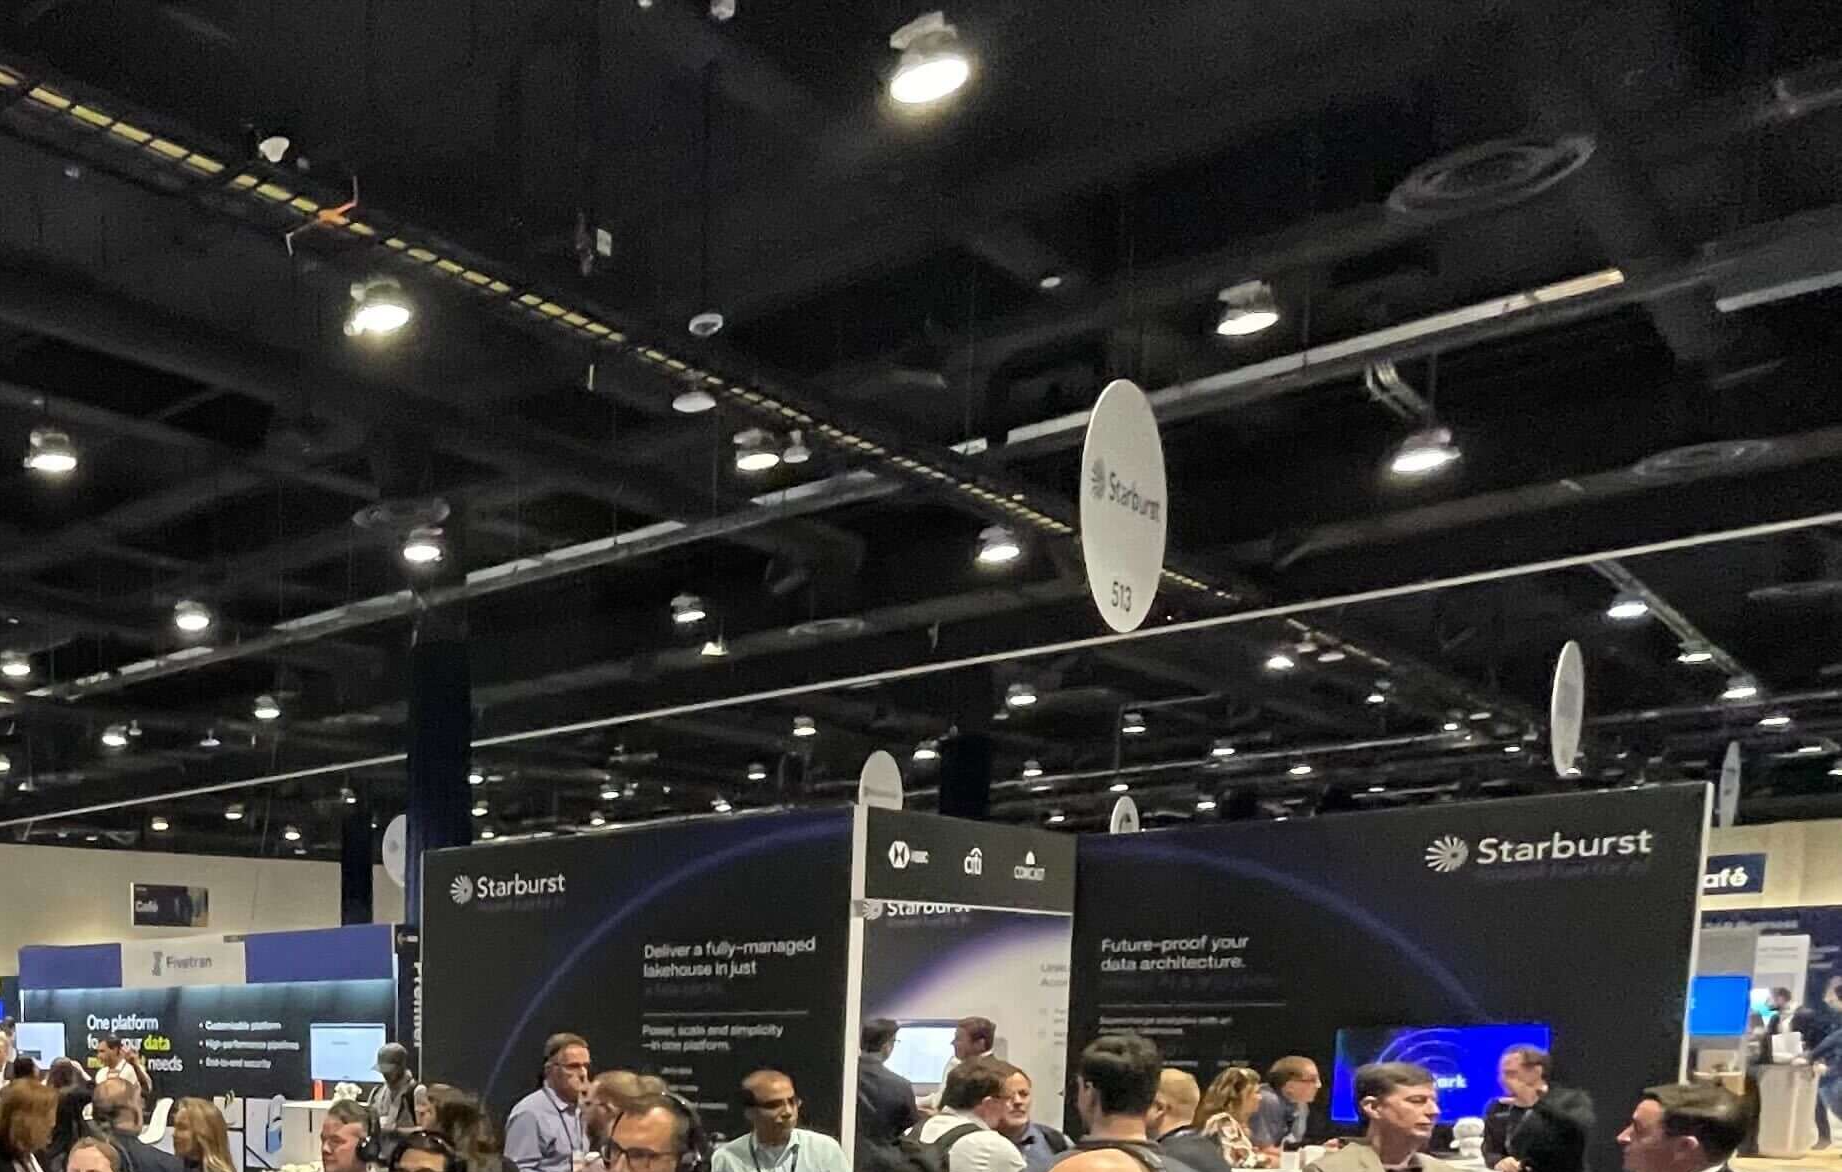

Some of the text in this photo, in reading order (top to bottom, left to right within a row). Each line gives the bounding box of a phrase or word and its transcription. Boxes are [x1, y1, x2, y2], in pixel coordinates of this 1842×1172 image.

[1109, 471, 1160, 522] Starburst
[1111, 581, 1133, 612] 513
[1477, 829, 1653, 864] Starburst
[477, 873, 566, 898] Starburst
[1703, 866, 1749, 889] afé
[644, 936, 816, 959] Deliver a fully-managed
[1101, 935, 1250, 954] Future-proof your
[166, 955, 213, 969] Fivetran
[643, 960, 757, 978] lakehouse in just
[1100, 955, 1246, 972] data architecture.
[87, 1014, 159, 1031] One platform
[143, 1035, 171, 1051] data
[148, 1055, 183, 1072] needs
